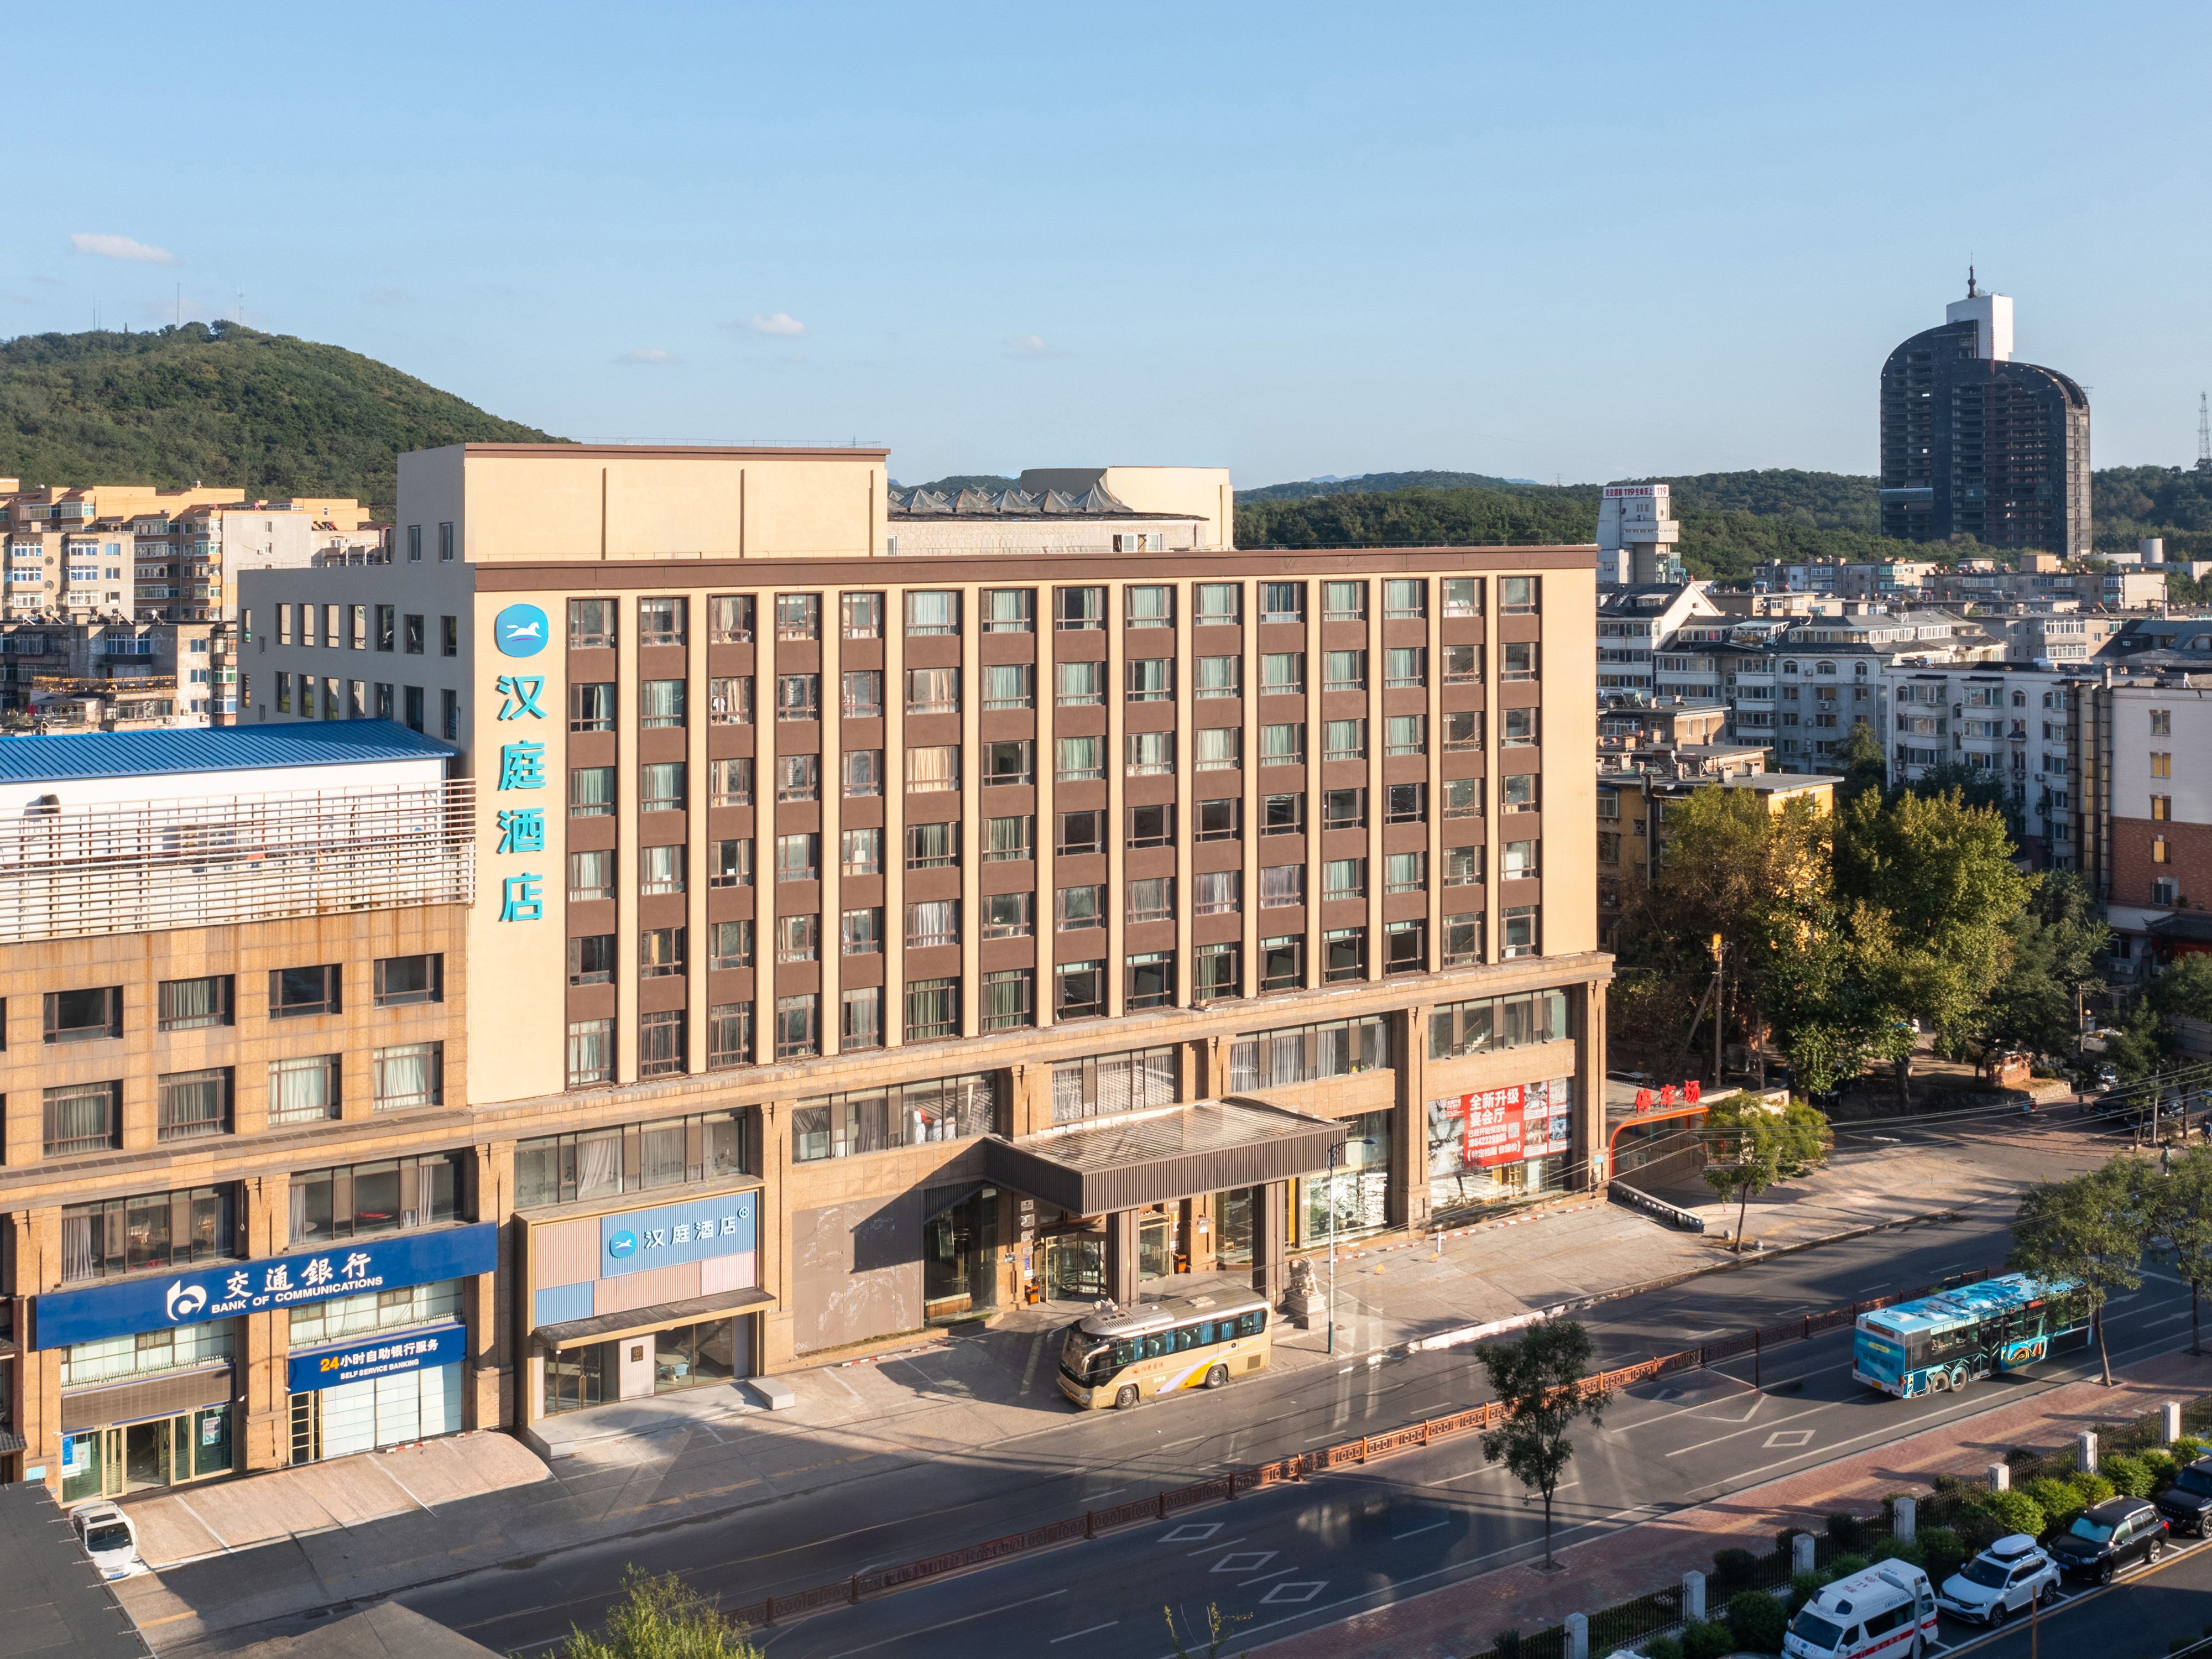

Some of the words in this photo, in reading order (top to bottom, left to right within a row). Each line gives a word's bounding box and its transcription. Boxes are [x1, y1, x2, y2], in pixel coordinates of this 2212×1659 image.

[1657, 487, 1667, 495] 119
[498, 675, 547, 922] 汉庭酒店
[1470, 1088, 1519, 1111] 全新升级
[1635, 1079, 1700, 1114] 停车场
[1470, 1107, 1505, 1128] 宴会厅
[645, 1216, 736, 1249] 汉庭酒店
[223, 1253, 372, 1299] 交通銀行
[211, 1298, 247, 1314] BANK
[252, 1295, 270, 1306] OF
[275, 1276, 383, 1303] COMMUNICATIONS
[340, 1370, 358, 1380] SELF
[358, 1365, 388, 1376] SERVICE
[389, 1358, 420, 1371] BANKING
